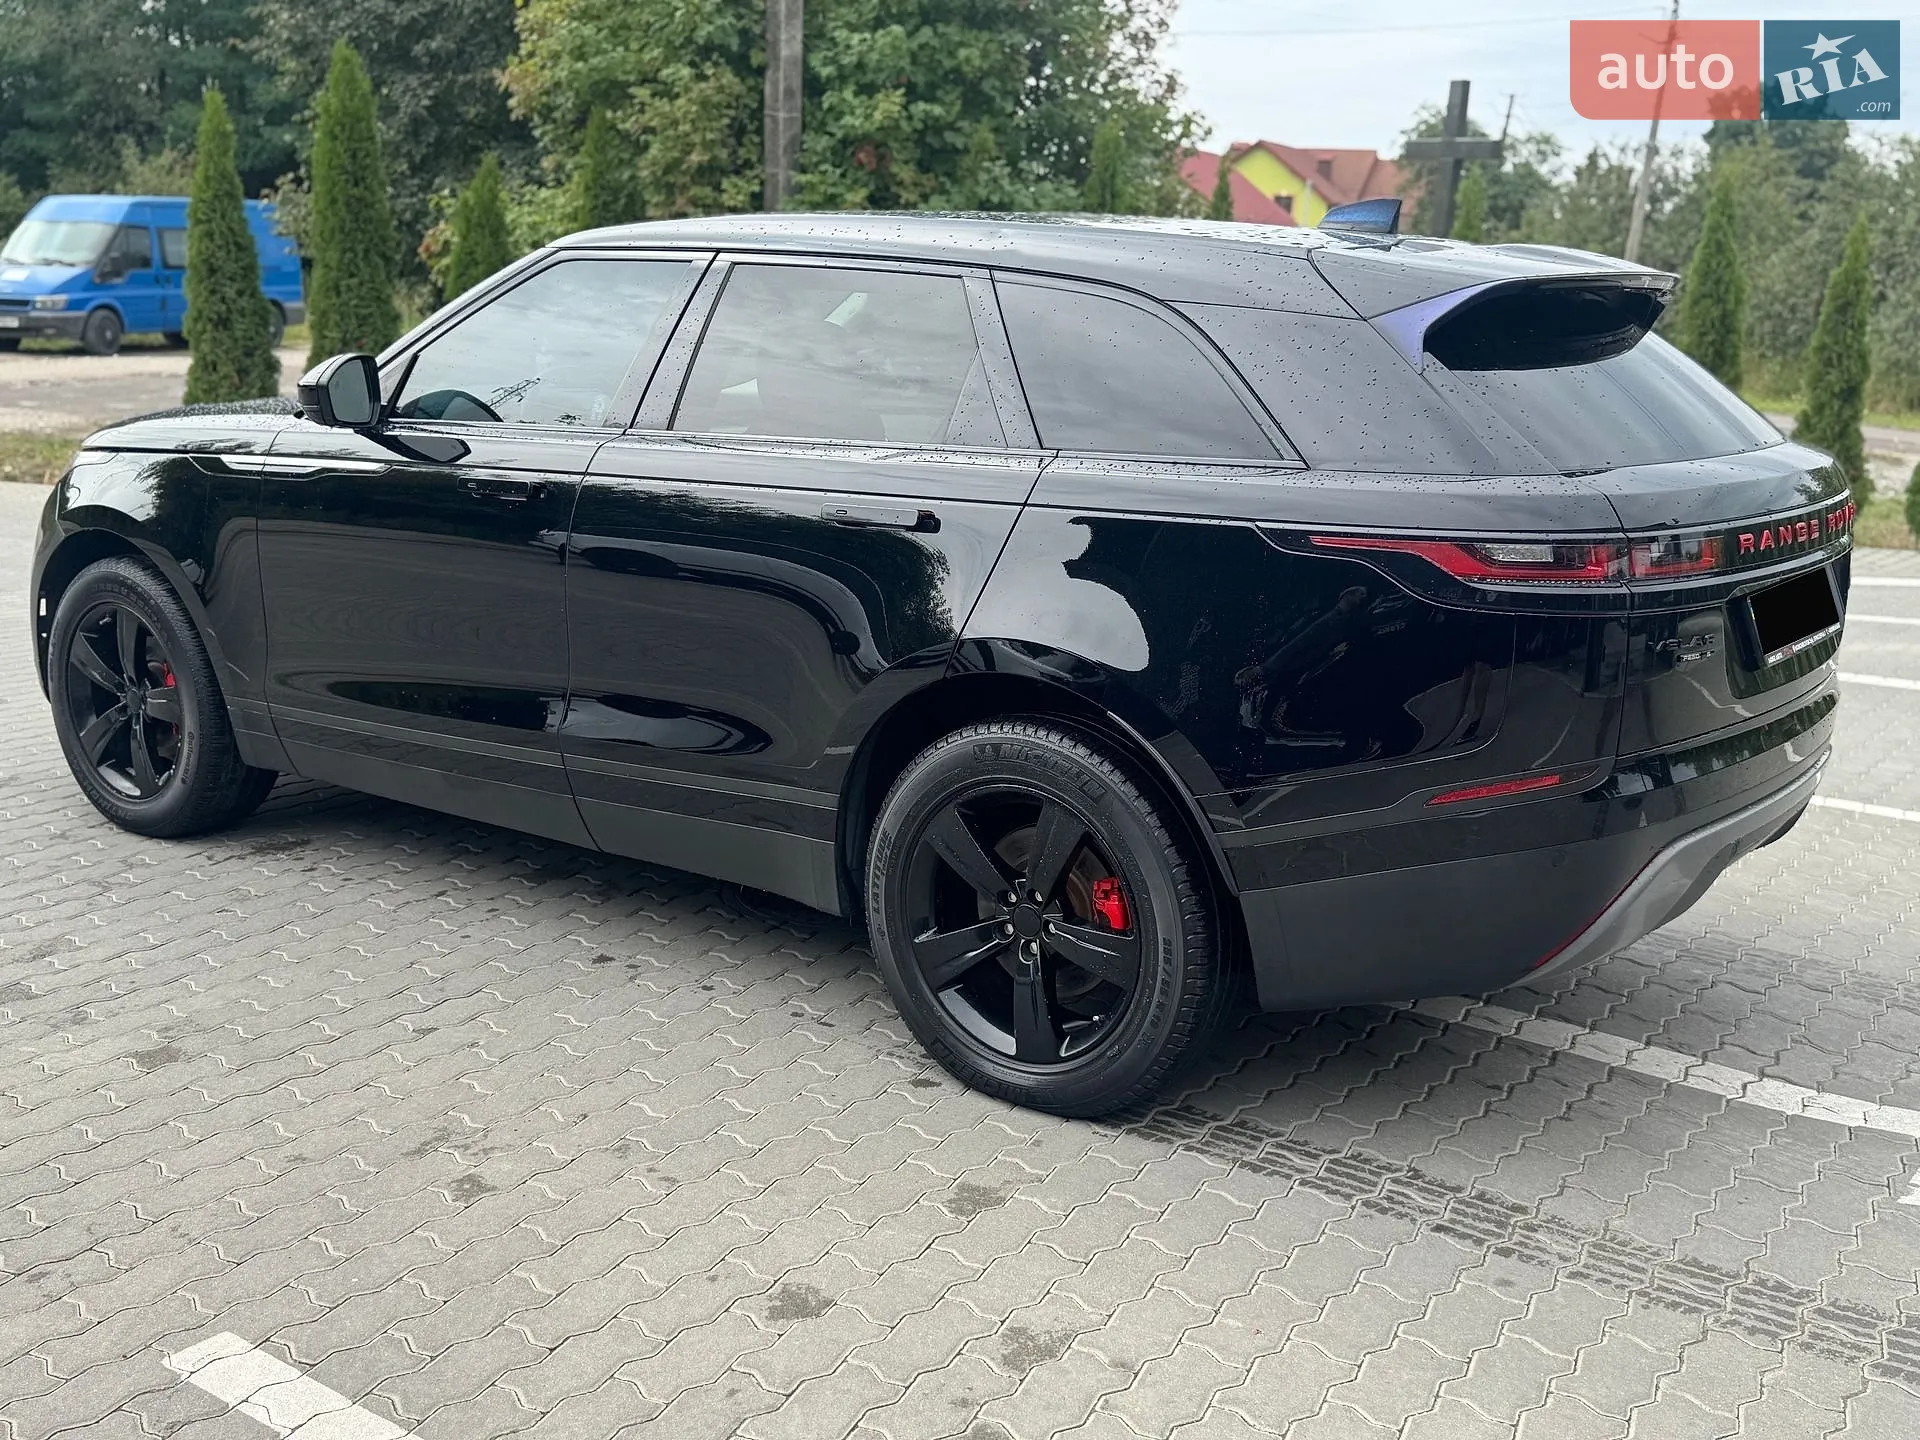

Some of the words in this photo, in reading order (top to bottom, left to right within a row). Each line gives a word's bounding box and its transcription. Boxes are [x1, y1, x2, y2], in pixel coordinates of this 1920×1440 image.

[1739, 519, 1820, 555] RANGE
[998, 743, 1107, 802] MICHELIN
[872, 827, 889, 910] LATITUDE
